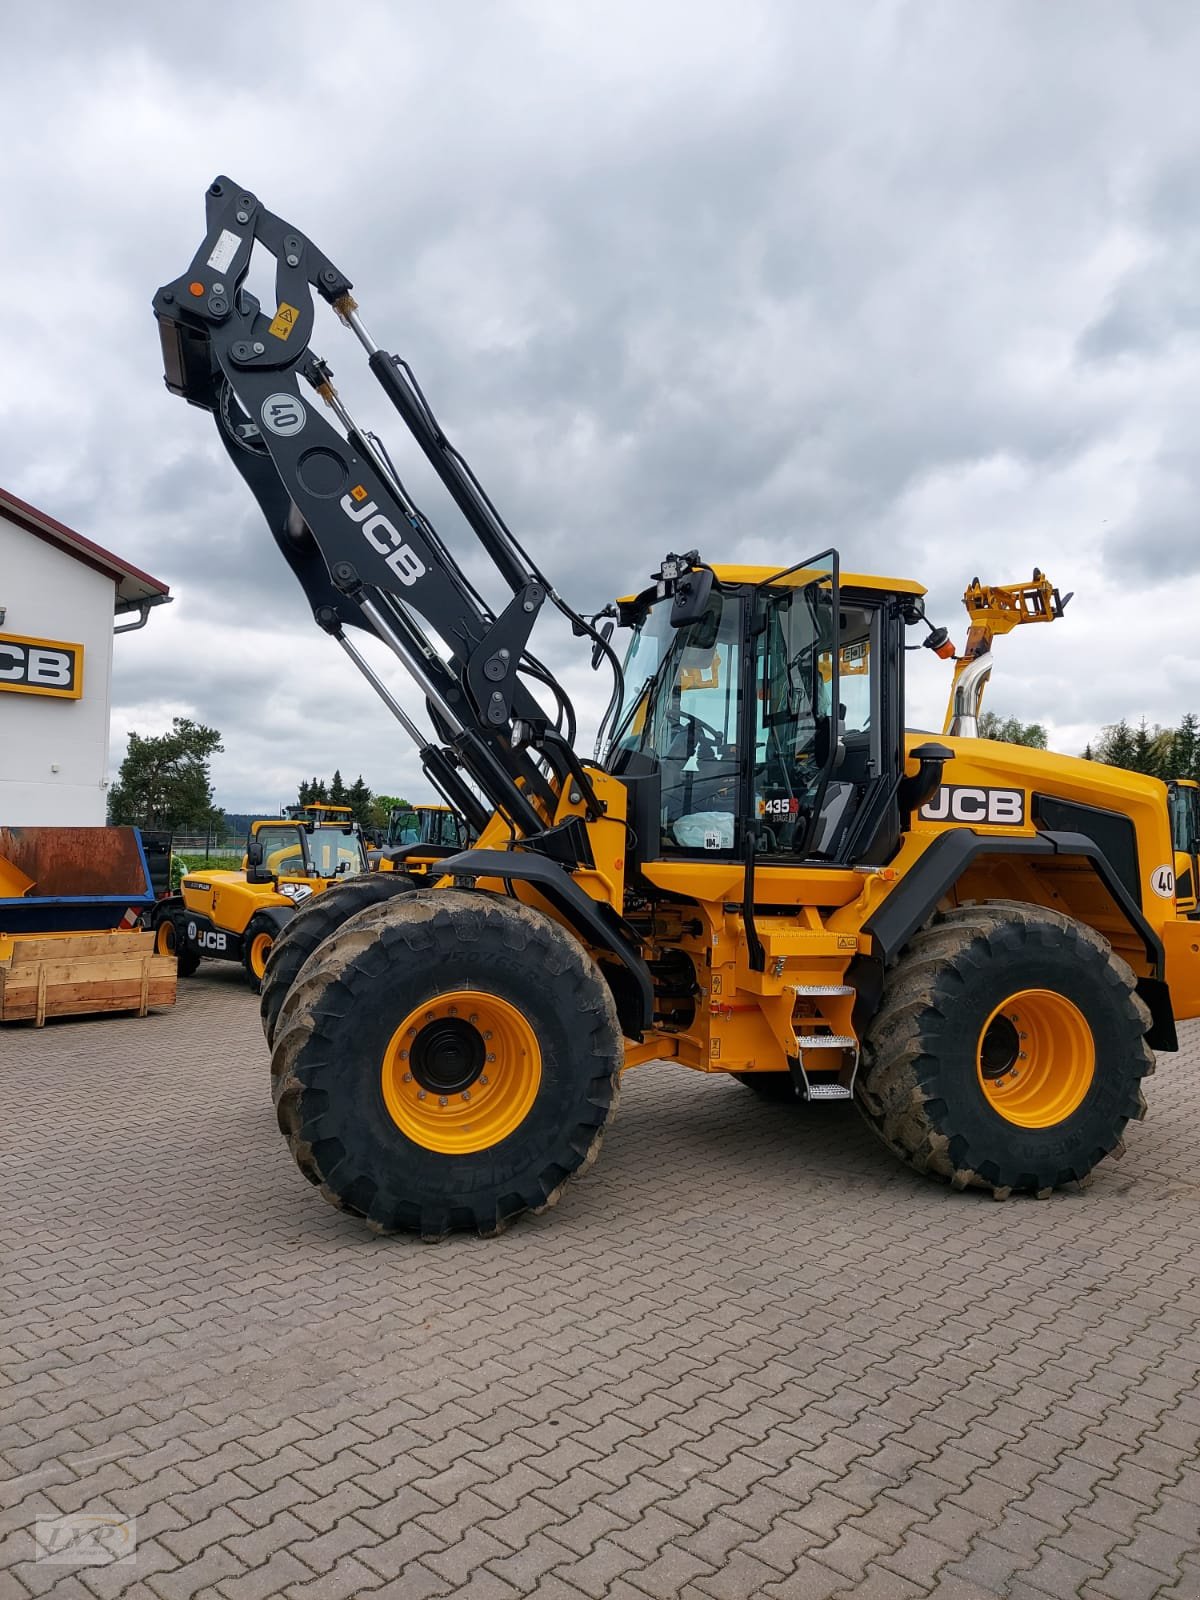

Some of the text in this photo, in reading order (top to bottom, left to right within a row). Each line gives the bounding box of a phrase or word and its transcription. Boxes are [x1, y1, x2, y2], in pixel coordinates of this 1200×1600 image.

[270, 403, 299, 428] 40
[340, 494, 426, 586] JCB
[921, 787, 1023, 823] JCB
[1158, 871, 1173, 891] 40
[198, 931, 227, 950] JCB
